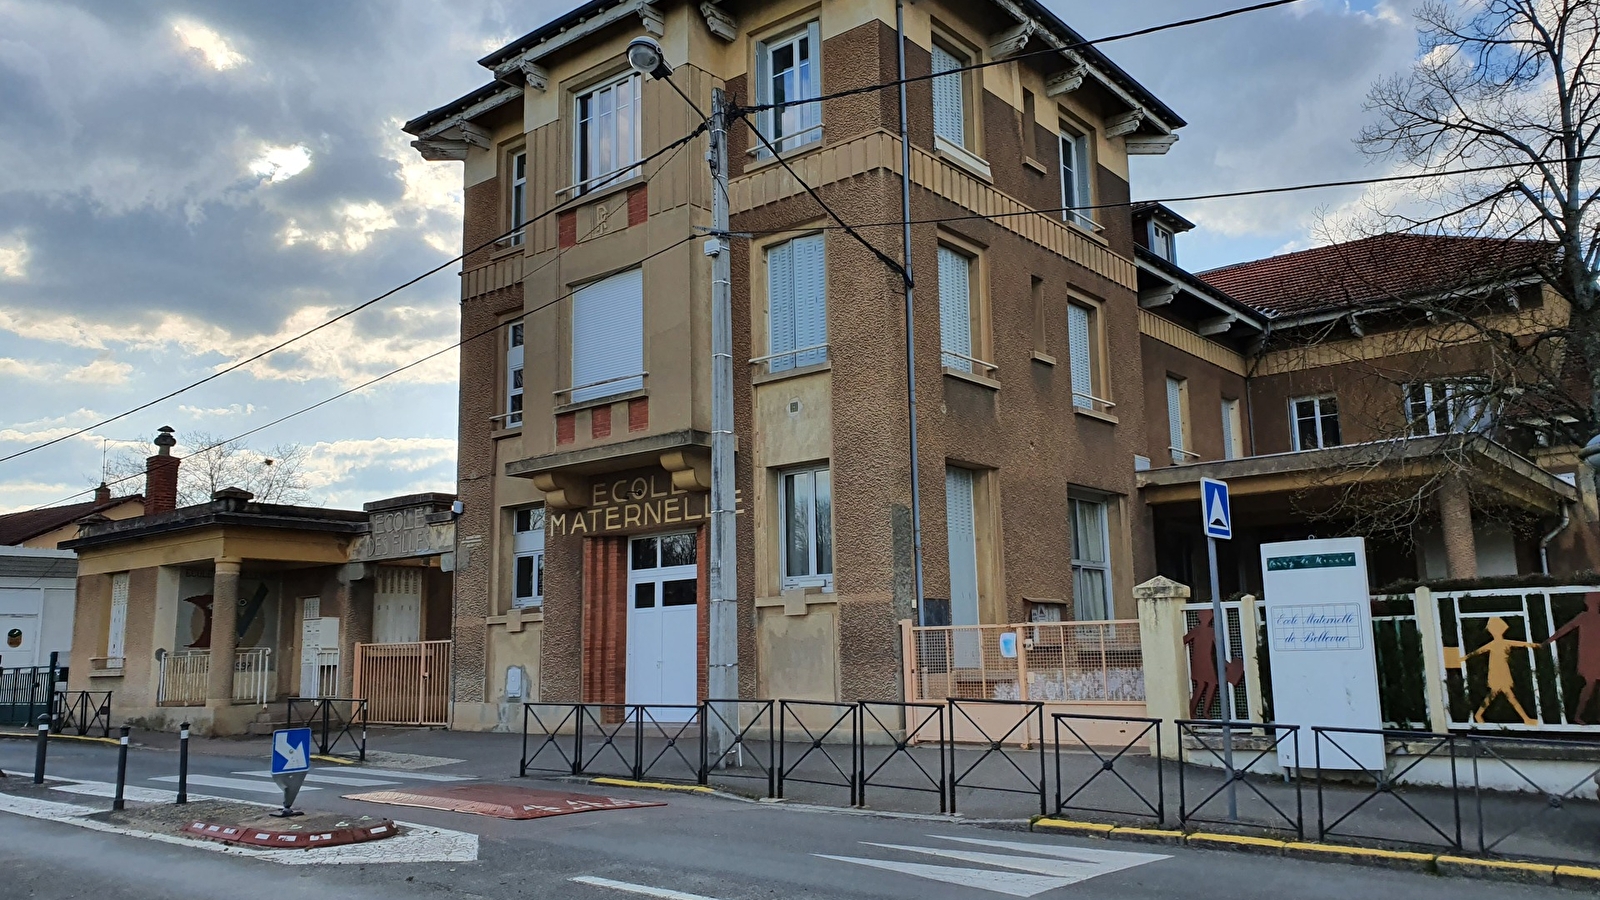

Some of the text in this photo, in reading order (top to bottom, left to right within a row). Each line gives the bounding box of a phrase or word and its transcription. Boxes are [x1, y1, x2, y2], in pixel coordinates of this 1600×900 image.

[374, 506, 426, 535] ECOLE
[366, 535, 388, 557] DES
[392, 529, 432, 555] FILLES
[1302, 612, 1355, 625] Maternelle
[1284, 630, 1348, 643] de Bellevue
